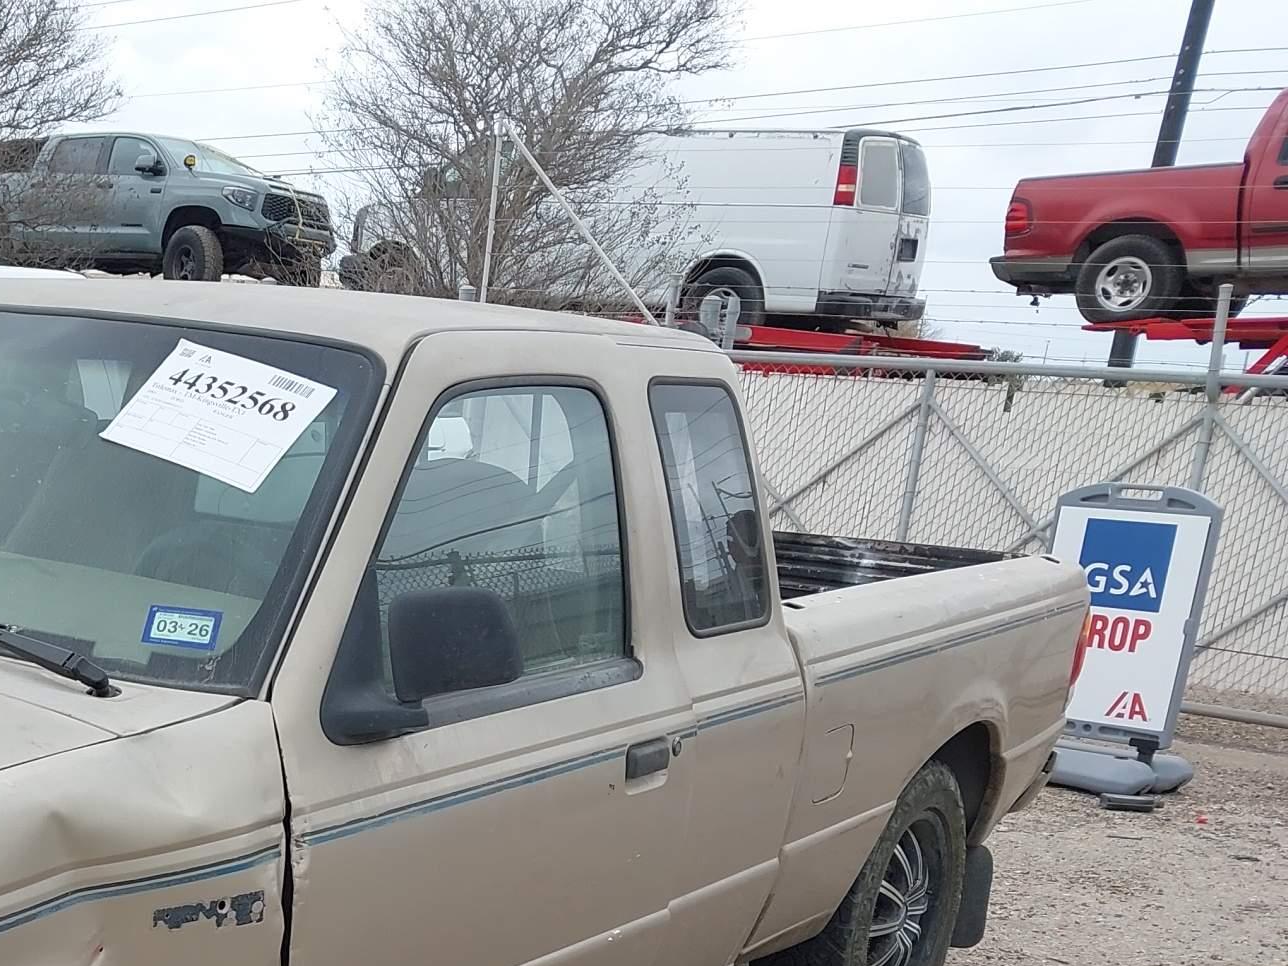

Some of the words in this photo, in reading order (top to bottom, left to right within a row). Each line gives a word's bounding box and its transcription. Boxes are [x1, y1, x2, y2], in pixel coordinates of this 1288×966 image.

[168, 368, 297, 422] 44352568
[1084, 562, 1157, 598] GSA
[156, 619, 179, 634] 03
[187, 622, 210, 638] 26
